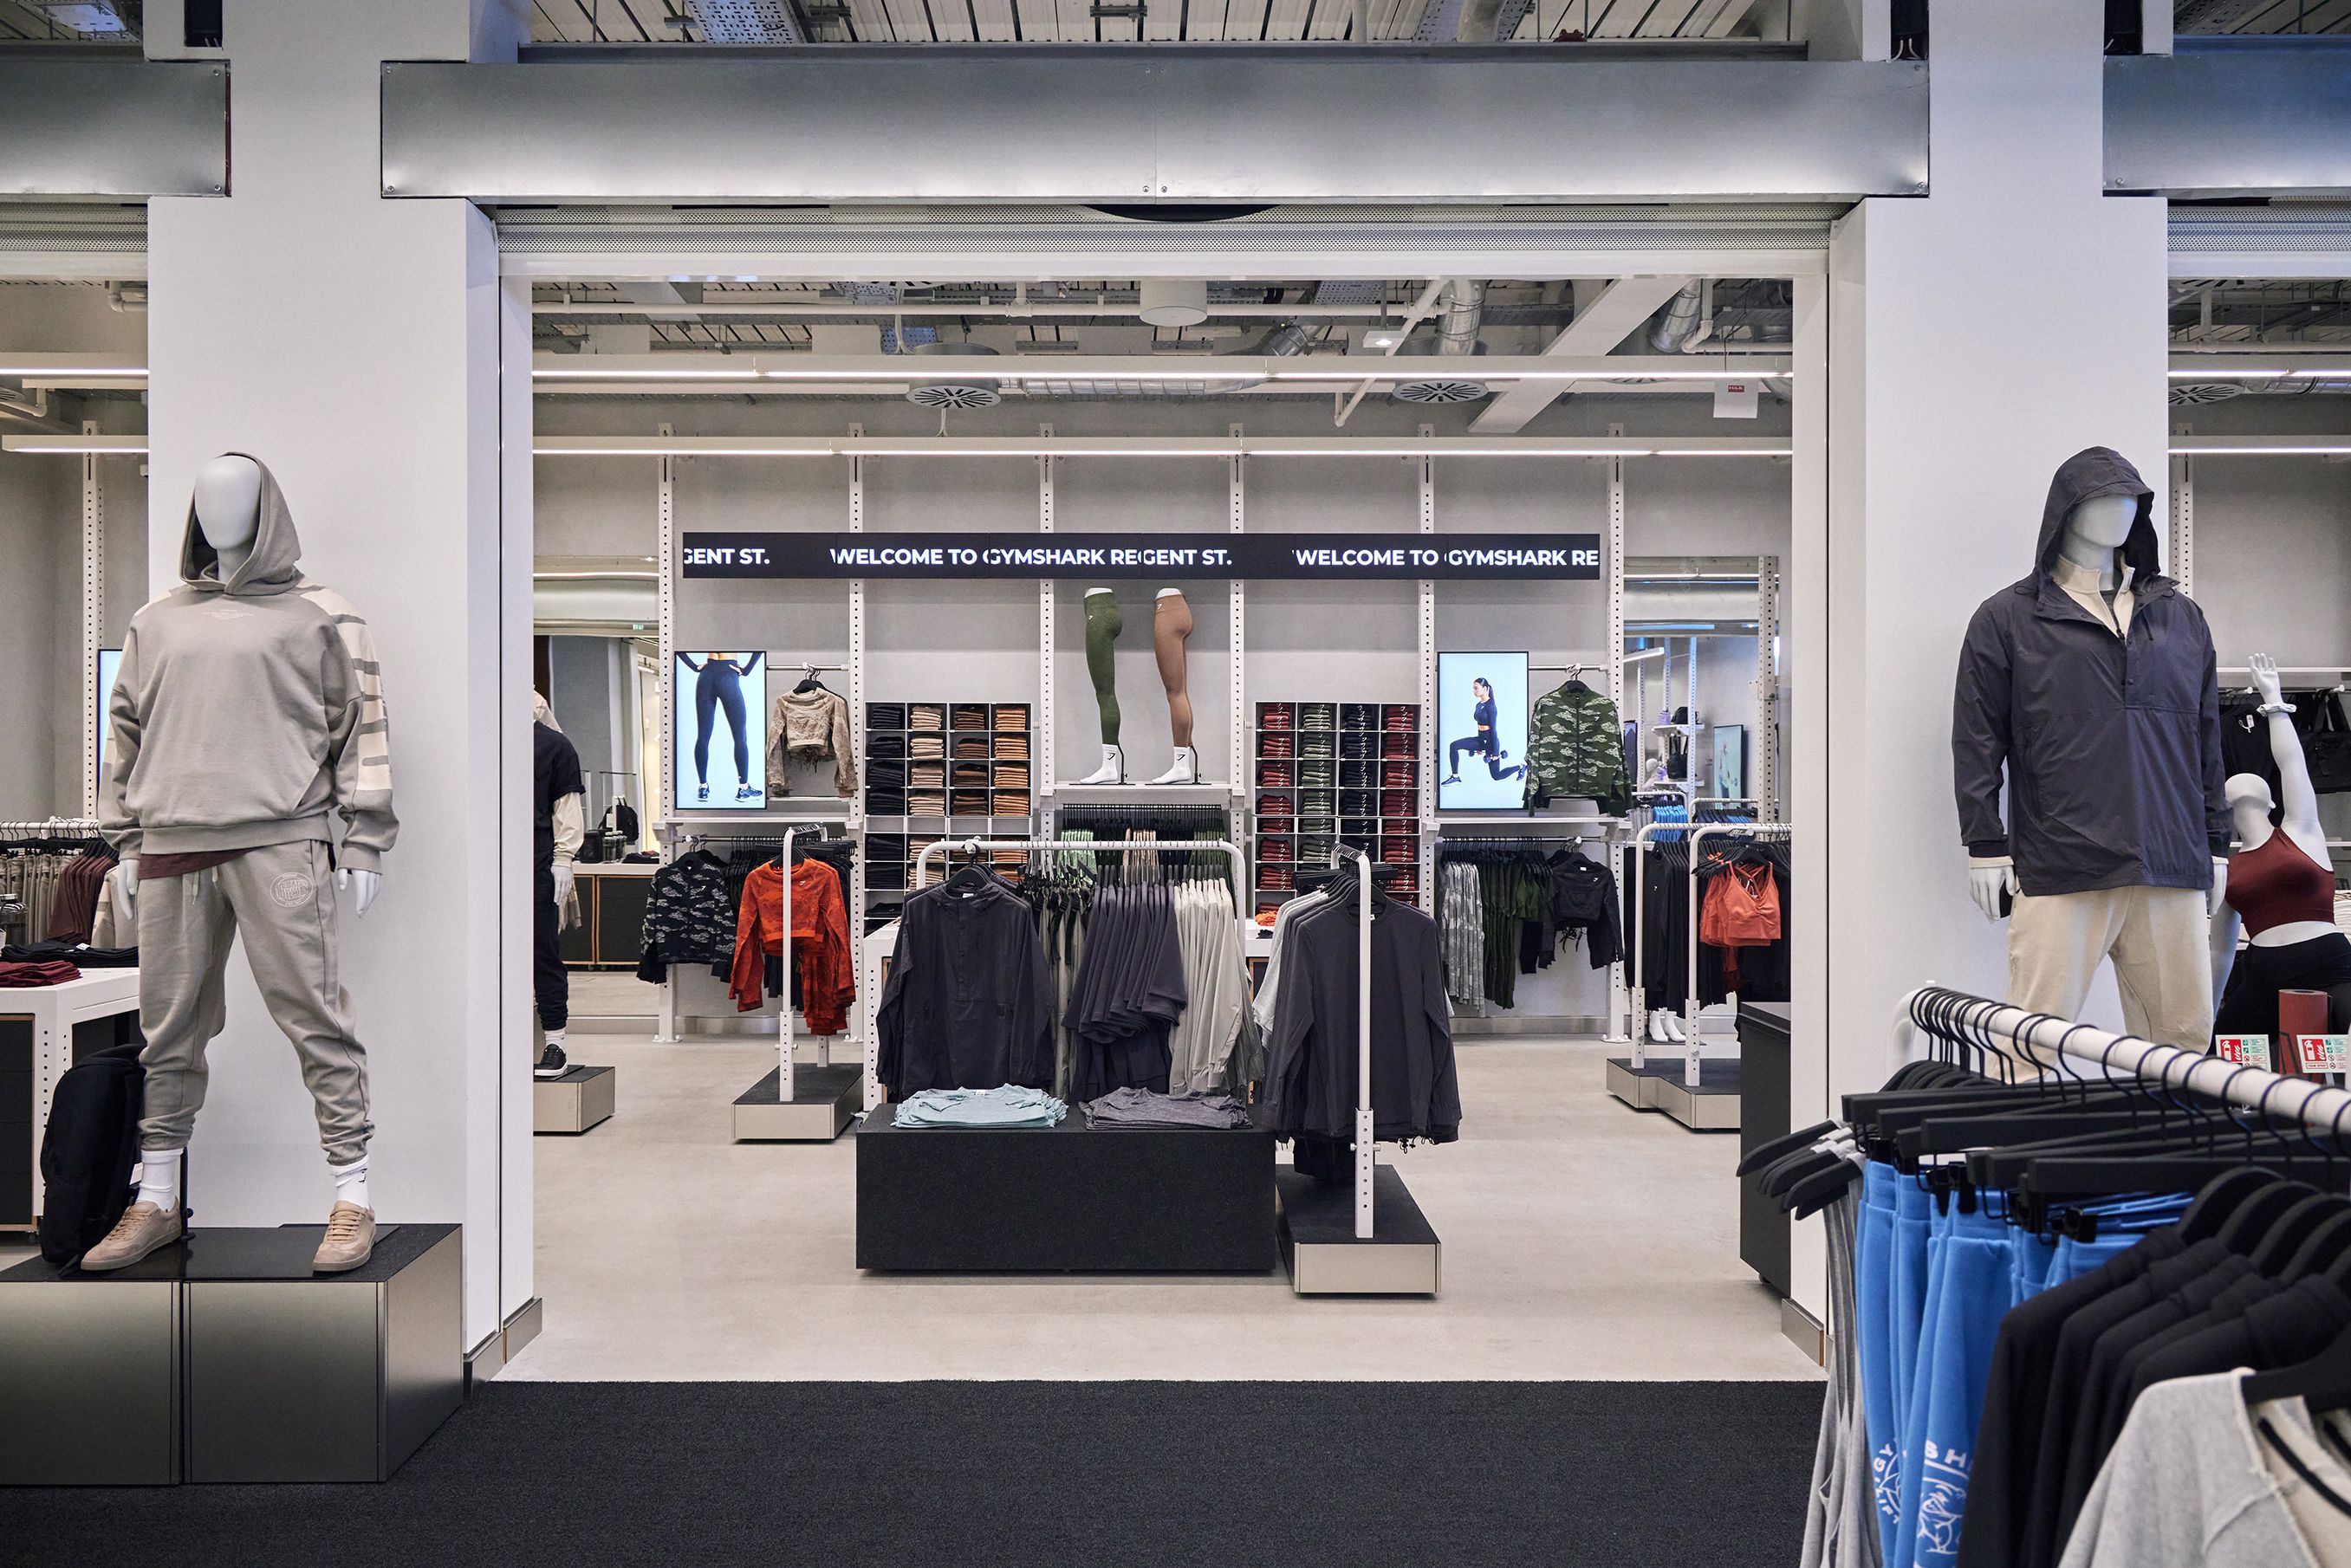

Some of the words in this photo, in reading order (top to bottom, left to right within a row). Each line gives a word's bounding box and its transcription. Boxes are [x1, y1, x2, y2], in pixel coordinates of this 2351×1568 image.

[739, 548, 770, 565] ST.
[830, 548, 944, 565] WELCOME
[948, 548, 977, 565] TO
[983, 548, 1106, 565] GYMSHARK
[1111, 548, 1198, 565] REGENT
[1202, 549, 1232, 566] ST.
[1295, 549, 1406, 566] WELCOME
[1410, 549, 1439, 566] TO
[1447, 549, 1568, 566] GYMSHARK
[1571, 549, 1600, 566] RE
